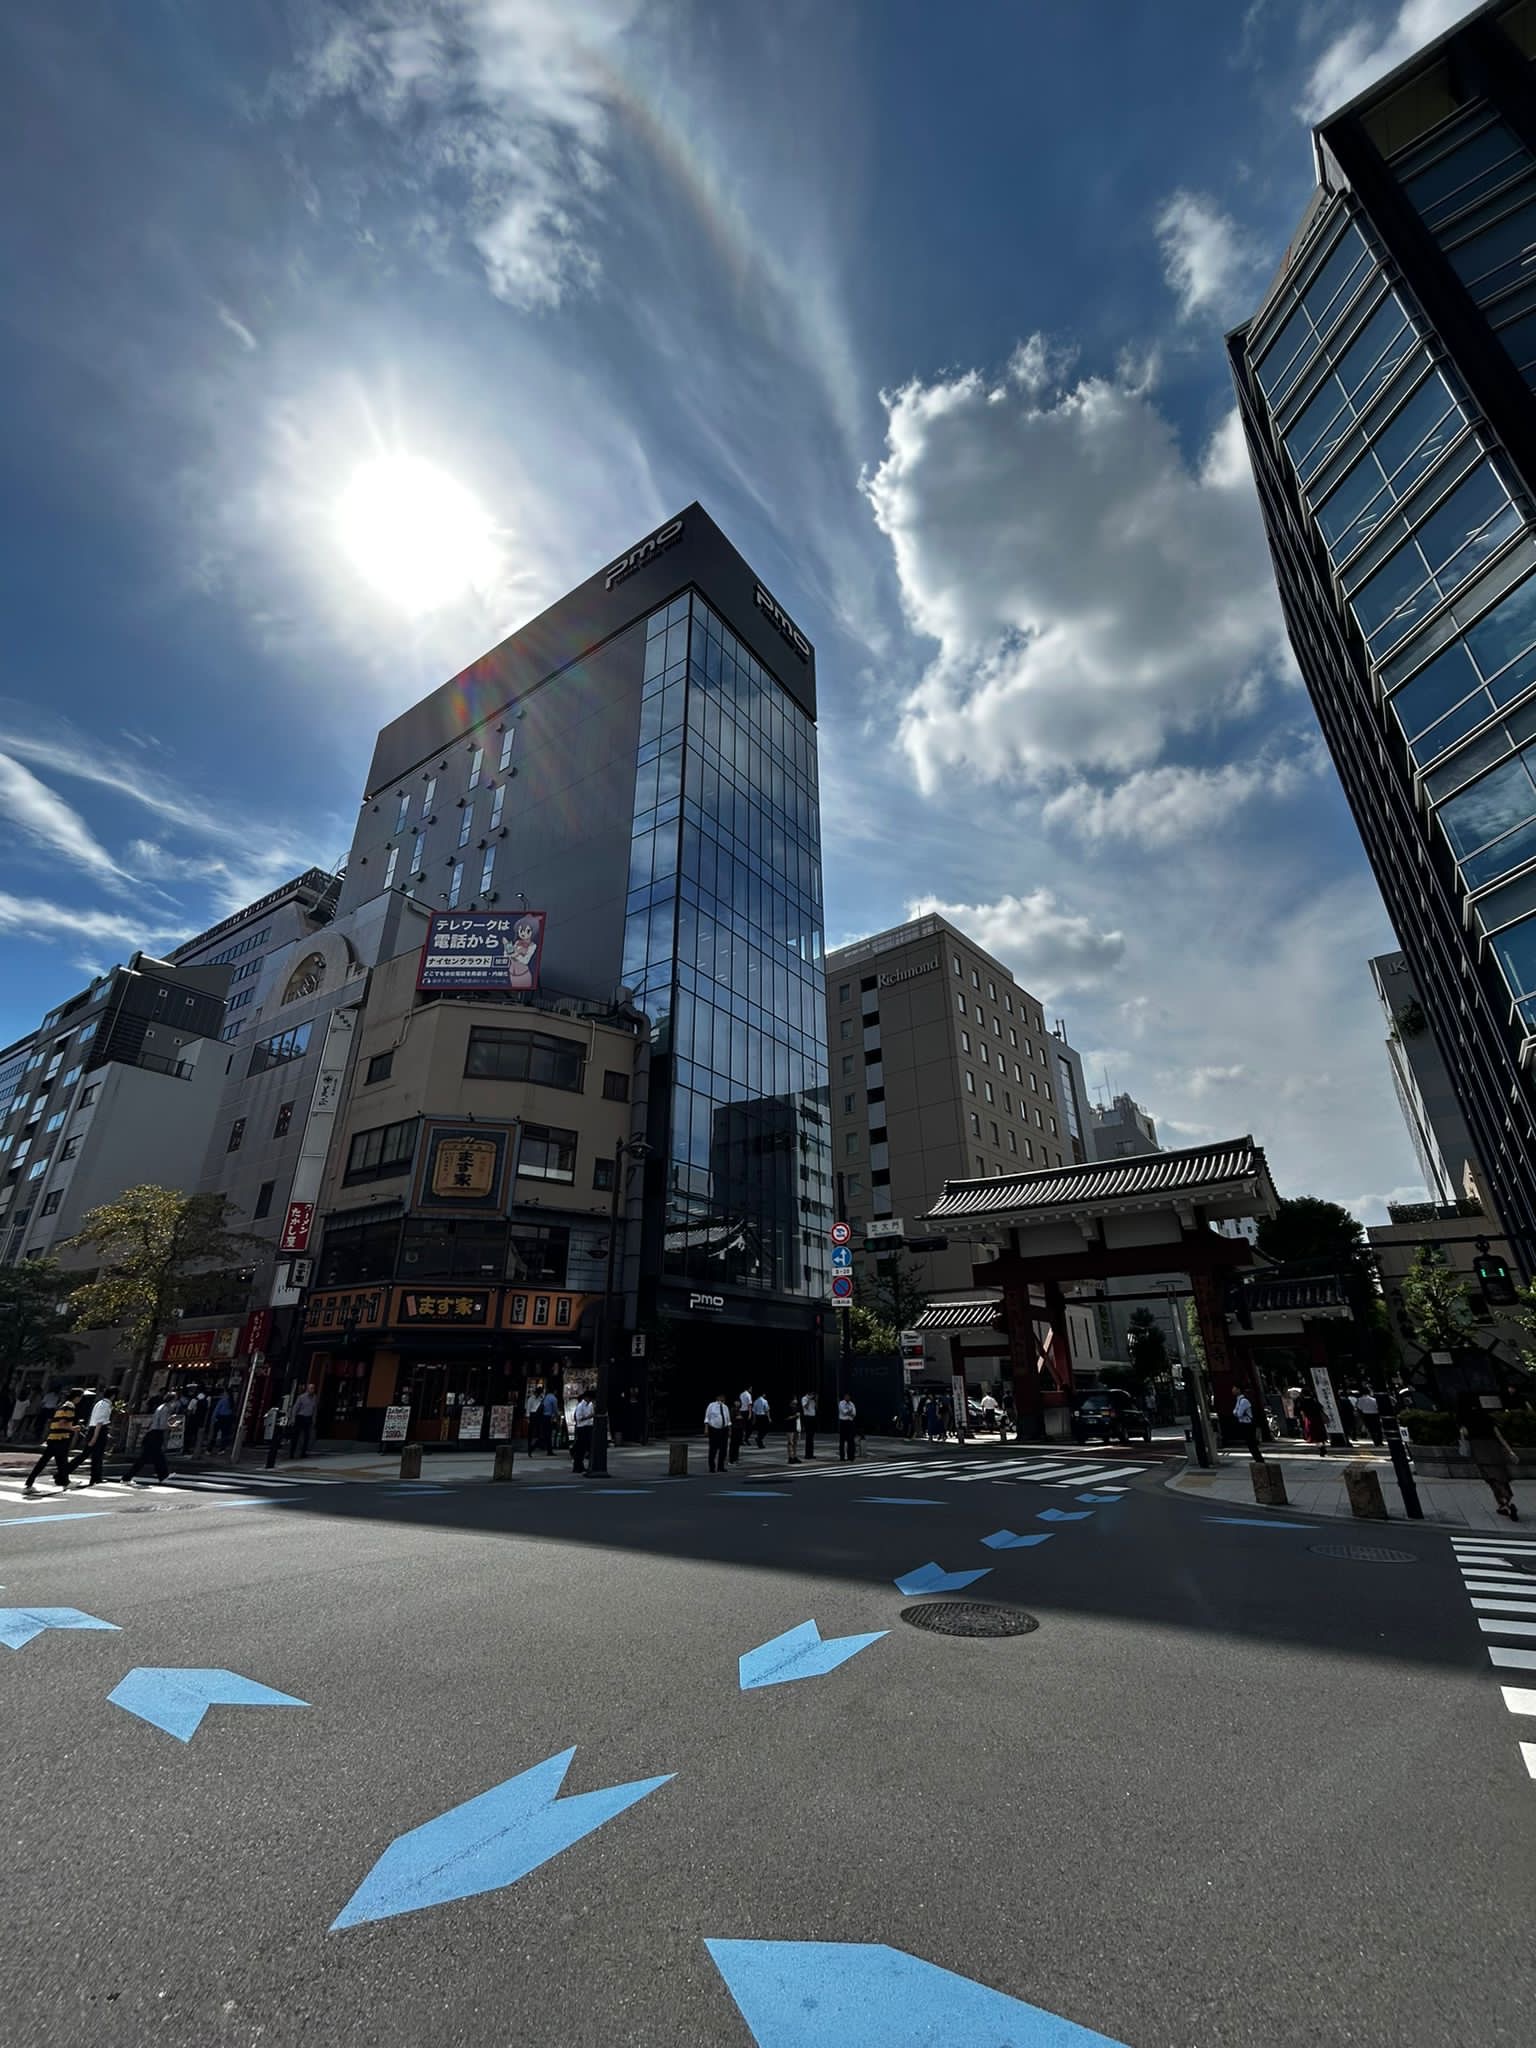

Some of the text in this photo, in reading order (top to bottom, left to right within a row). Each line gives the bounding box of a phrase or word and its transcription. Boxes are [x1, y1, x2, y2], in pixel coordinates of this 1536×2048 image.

[605, 520, 683, 592] pmo
[755, 583, 810, 656] pmo
[436, 919, 511, 931] テレワークは
[433, 933, 499, 949] 電話から
[428, 957, 491, 966] ナイセンクラウド
[877, 954, 939, 989] Richmond
[299, 1204, 313, 1235] ラーメン
[418, 1296, 474, 1316] ます家
[690, 1292, 724, 1309] pmo
[169, 1343, 209, 1360] SIMONE
